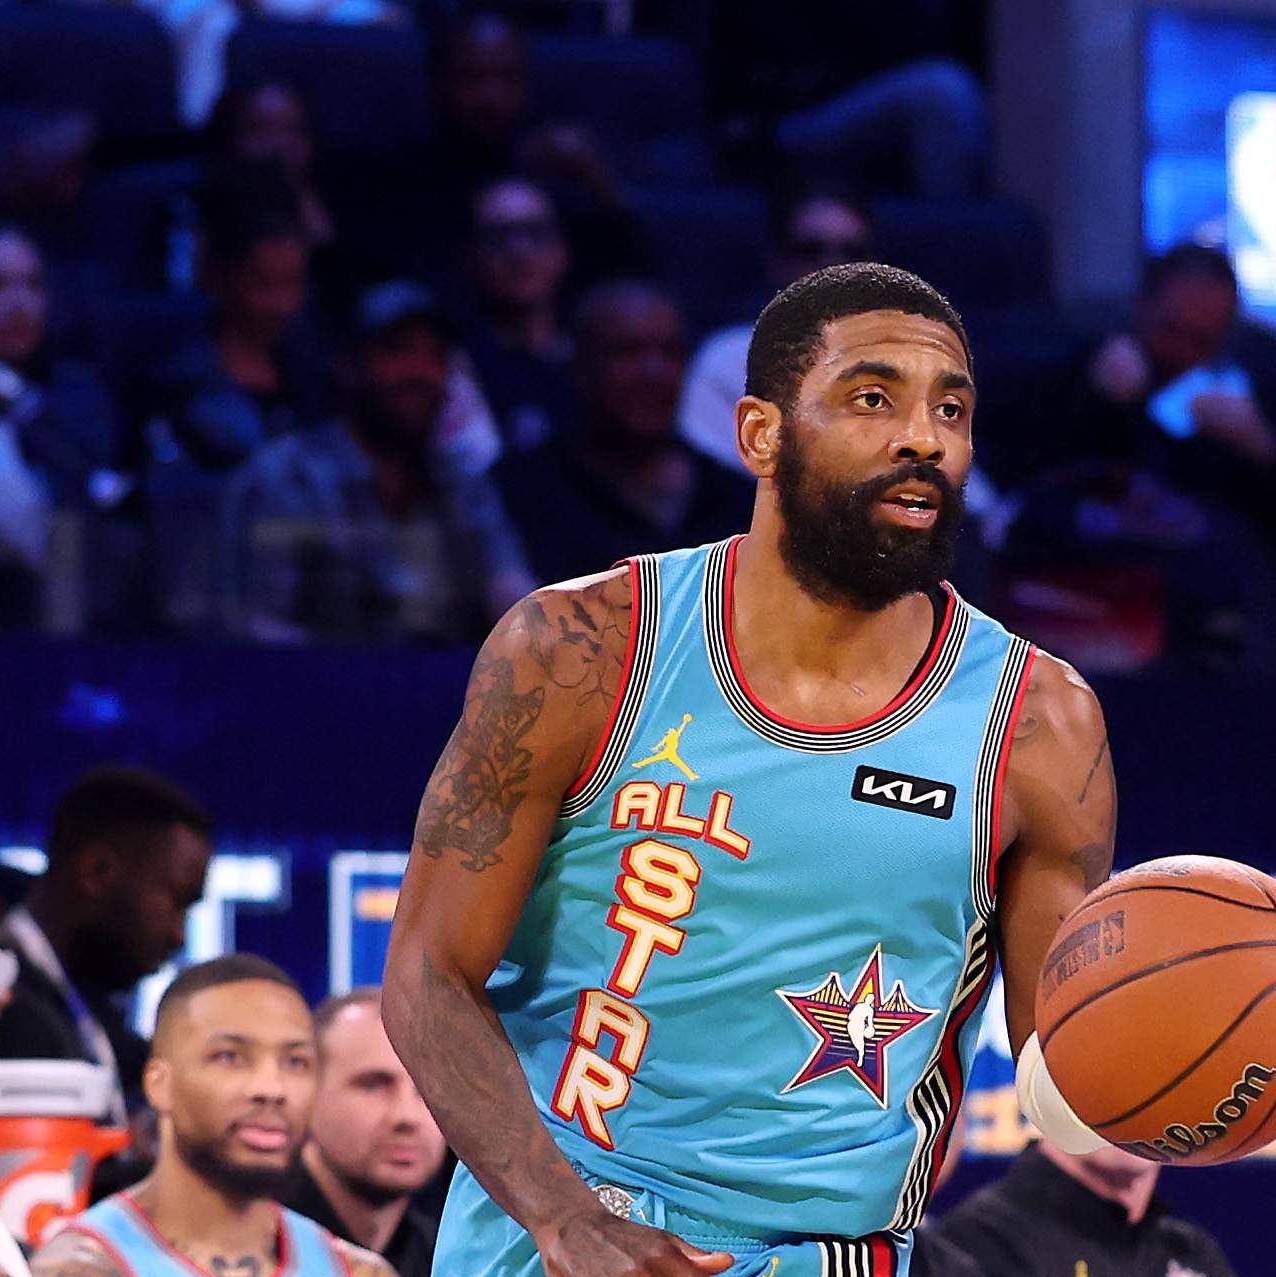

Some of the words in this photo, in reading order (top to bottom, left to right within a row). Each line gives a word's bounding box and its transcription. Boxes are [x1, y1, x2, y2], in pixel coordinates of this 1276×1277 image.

[611, 781, 751, 860] ALL
[862, 775, 947, 809] KIA
[550, 838, 702, 1151] STAR
